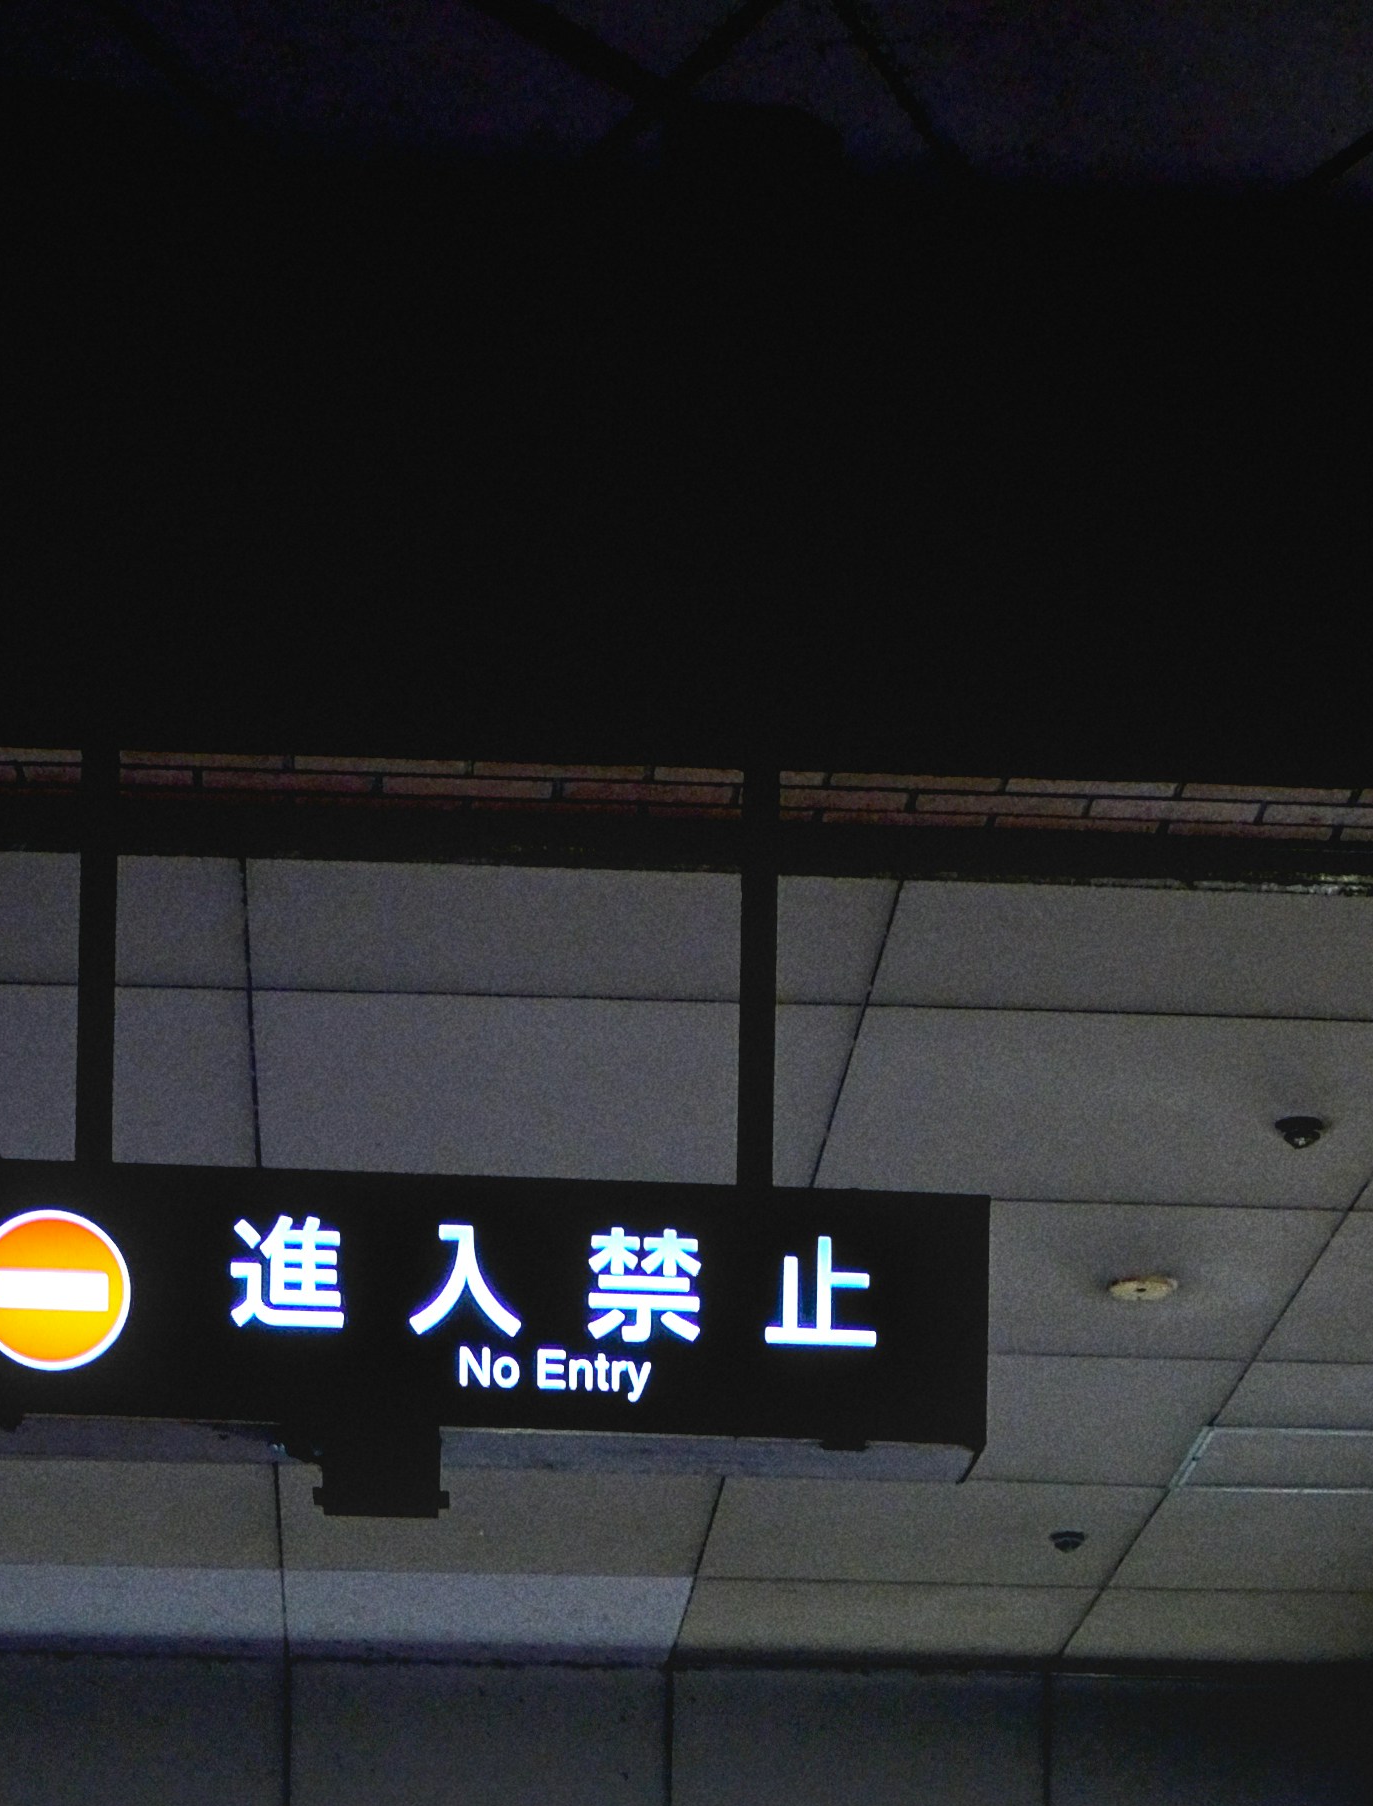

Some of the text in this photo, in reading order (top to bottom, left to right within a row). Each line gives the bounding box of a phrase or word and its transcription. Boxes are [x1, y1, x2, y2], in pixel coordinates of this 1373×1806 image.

[229, 1216, 877, 1347] 進入禁止
[459, 1348, 651, 1402] No Entry
